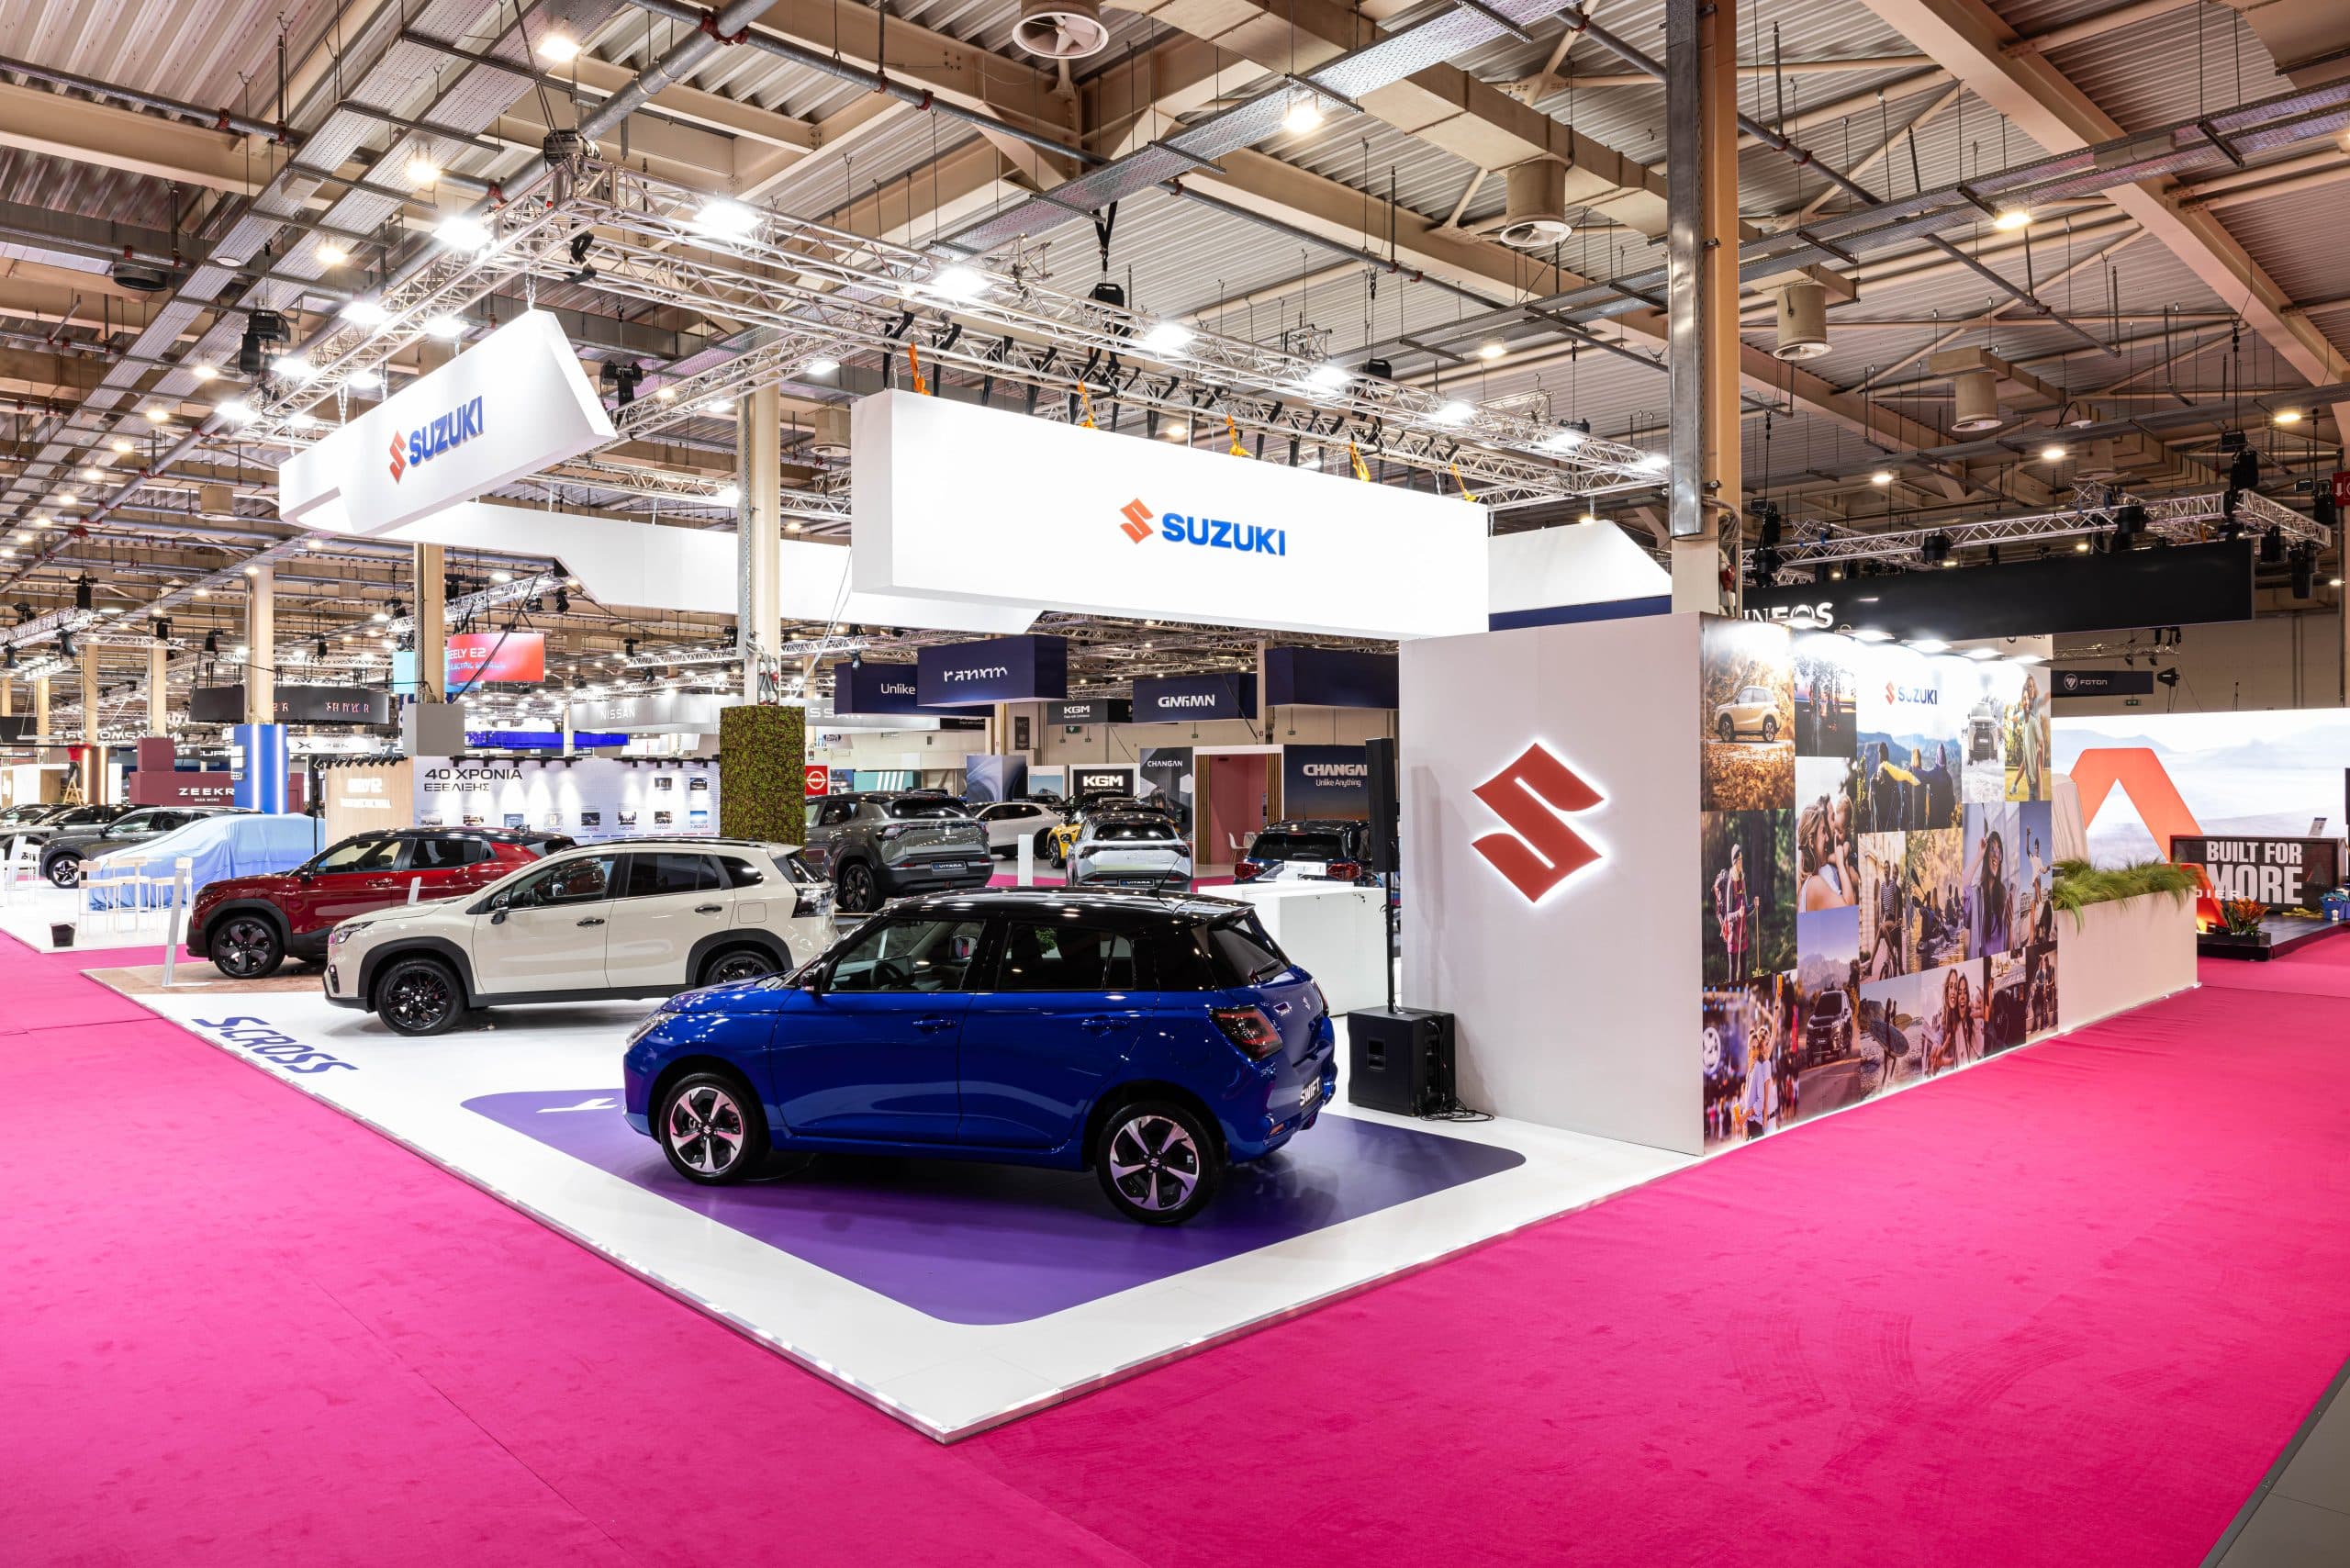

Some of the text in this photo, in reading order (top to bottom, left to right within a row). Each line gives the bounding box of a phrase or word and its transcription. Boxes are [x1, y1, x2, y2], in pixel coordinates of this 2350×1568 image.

[408, 395, 484, 467] SUZUKI
[1161, 512, 1285, 556] SUZUKI
[1743, 601, 1834, 629] INEOS
[880, 683, 916, 695] Unlike
[1897, 689, 1938, 705] SUZUKI
[599, 707, 636, 721] NISSAN
[1063, 705, 1091, 714] KGM
[1147, 759, 1183, 767] CHANGAN
[424, 768, 523, 780] 40 ΧΡΟΝΙΑ
[424, 783, 489, 792] ΕΞΕΛΙΞΗΣ
[1082, 775, 1124, 787] KGM
[1315, 778, 1361, 788] Unlike Anything
[178, 788, 235, 796] ZEEKR
[2206, 840, 2303, 864] BUILT FOR
[2206, 863, 2303, 905] MORE
[1299, 1075, 1321, 1106] SWIFT
